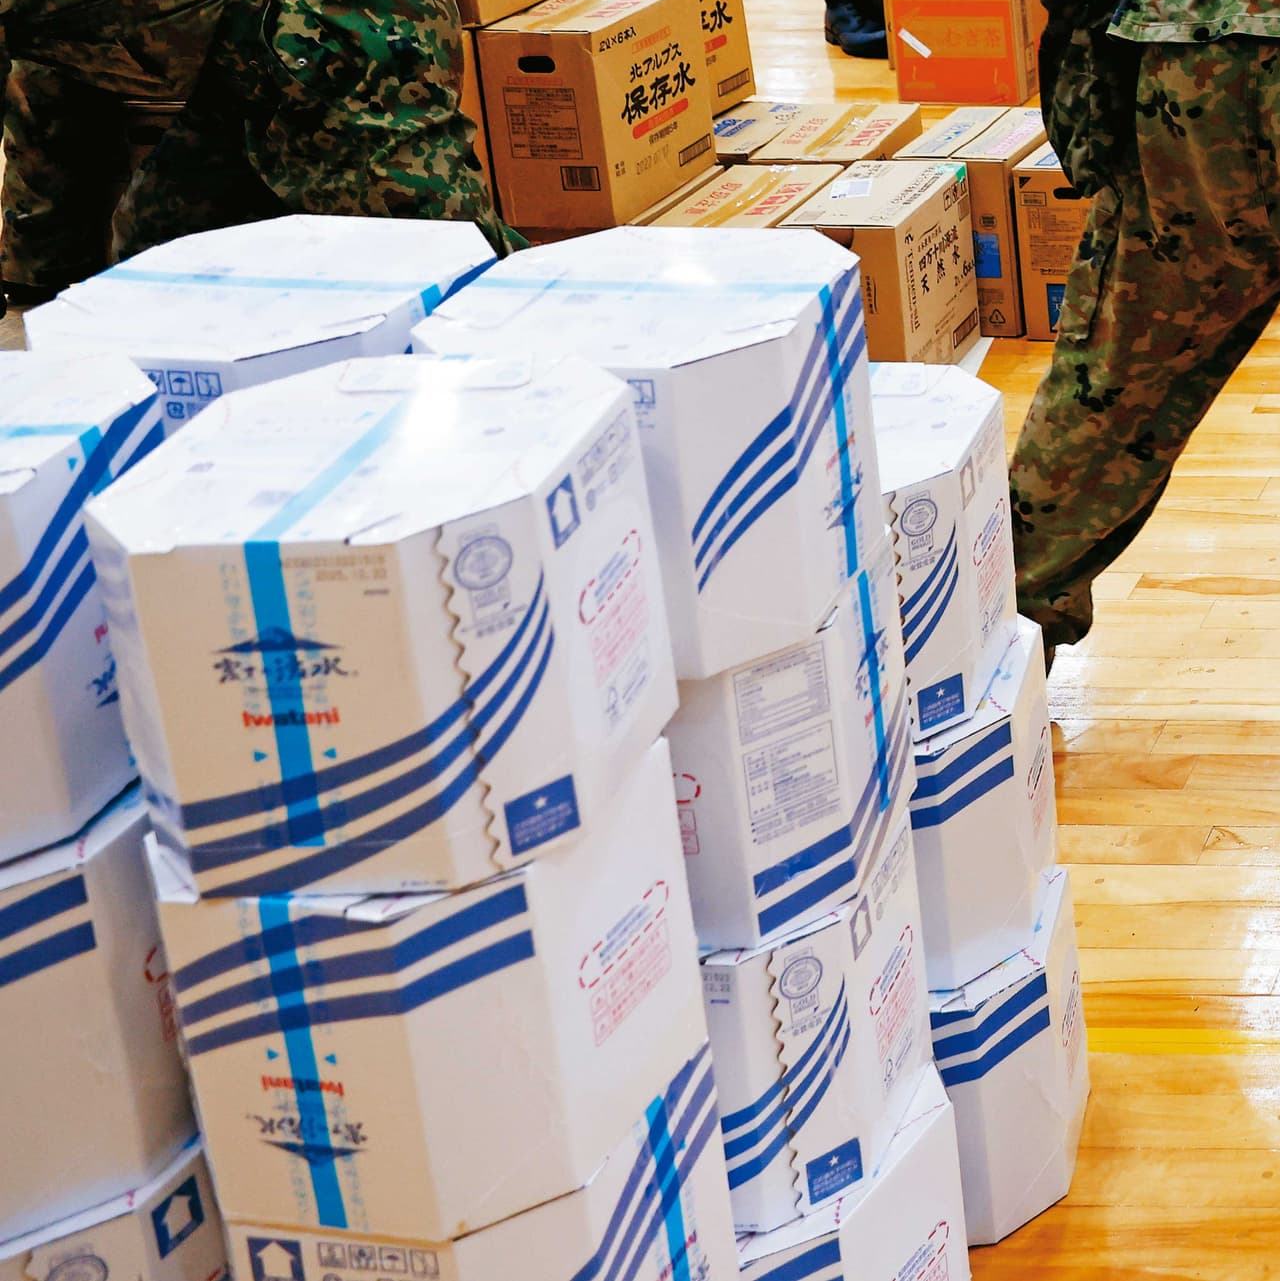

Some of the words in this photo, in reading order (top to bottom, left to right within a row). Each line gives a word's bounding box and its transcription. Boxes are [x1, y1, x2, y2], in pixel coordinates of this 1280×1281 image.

[629, 42, 683, 83] 北アルプス
[621, 61, 697, 125] 保存水
[242, 706, 341, 728] Iwatani
[261, 1074, 345, 1098] Iwatani
